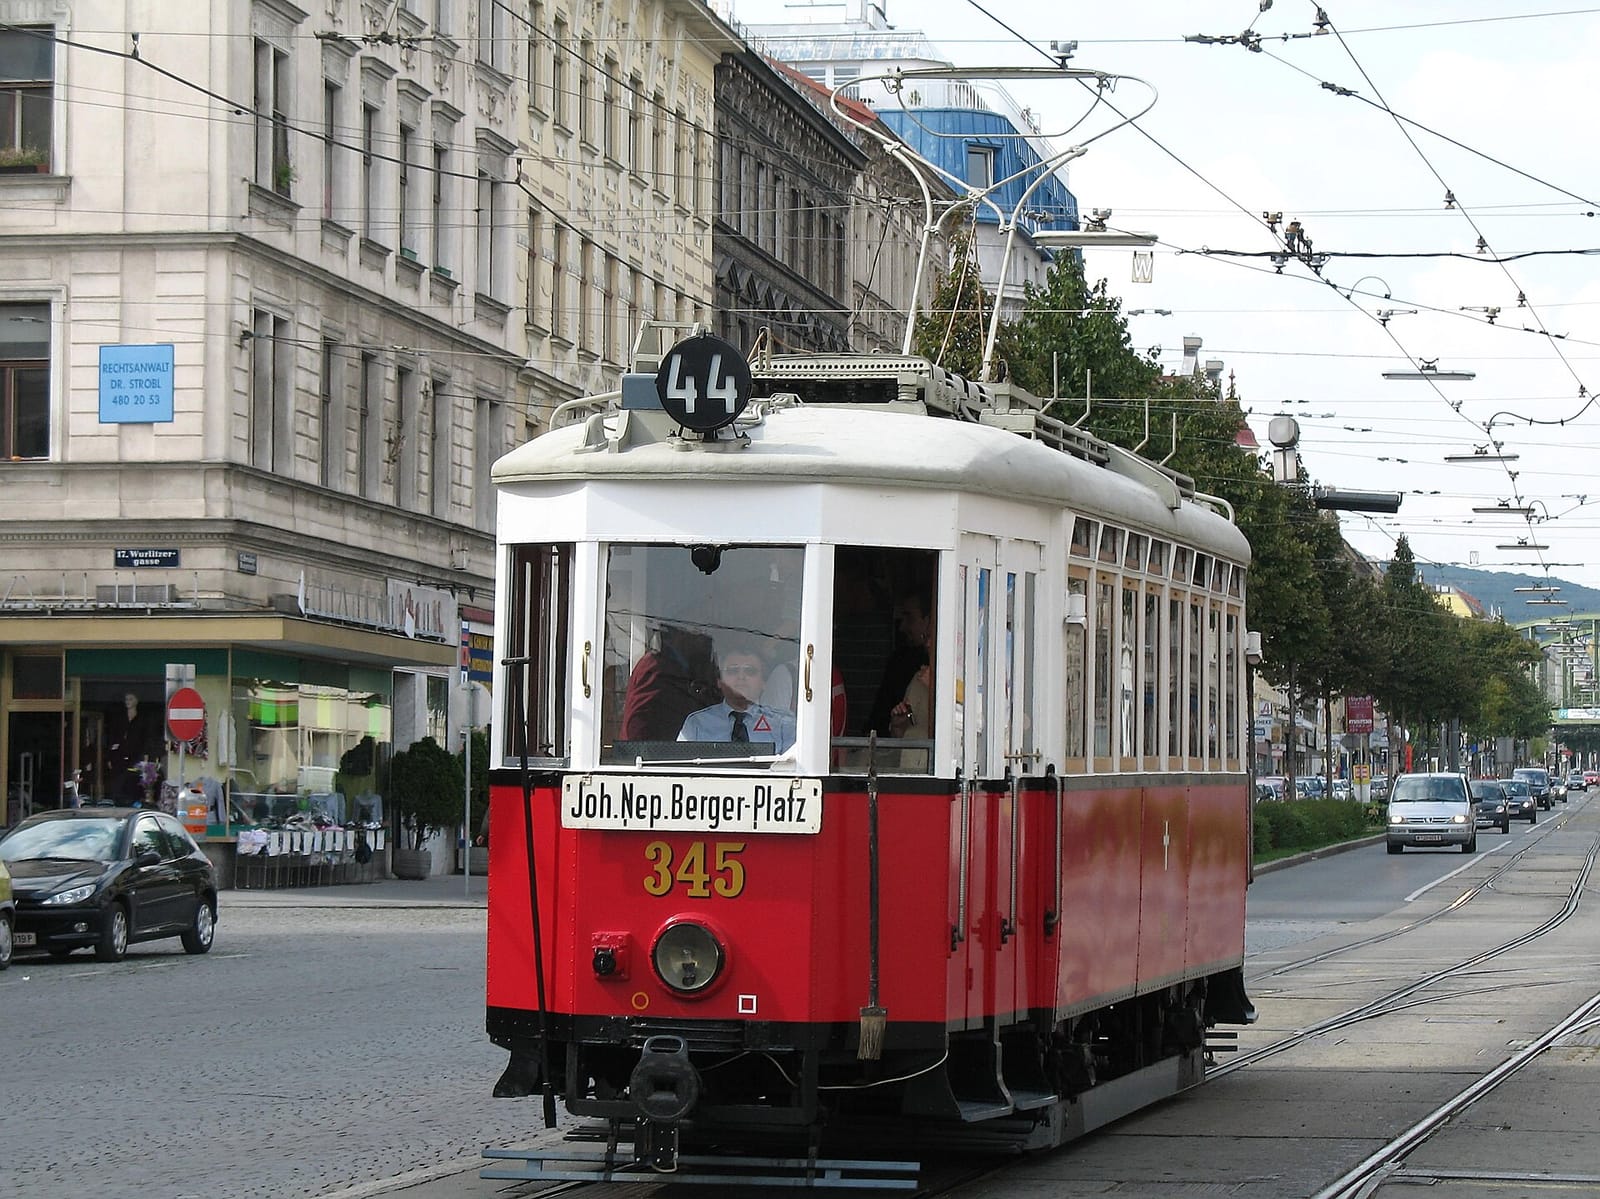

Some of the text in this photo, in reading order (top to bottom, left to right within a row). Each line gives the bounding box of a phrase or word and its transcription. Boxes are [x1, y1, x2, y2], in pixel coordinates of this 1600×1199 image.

[102, 362, 170, 373] RECHTSANWALT
[110, 378, 162, 390] DR. STROBL
[666, 353, 738, 414] 44
[112, 394, 161, 406] 480 20 53
[116, 550, 177, 559] 17. Wurlitzer-
[133, 558, 161, 567] gasse
[642, 840, 747, 898] 345
